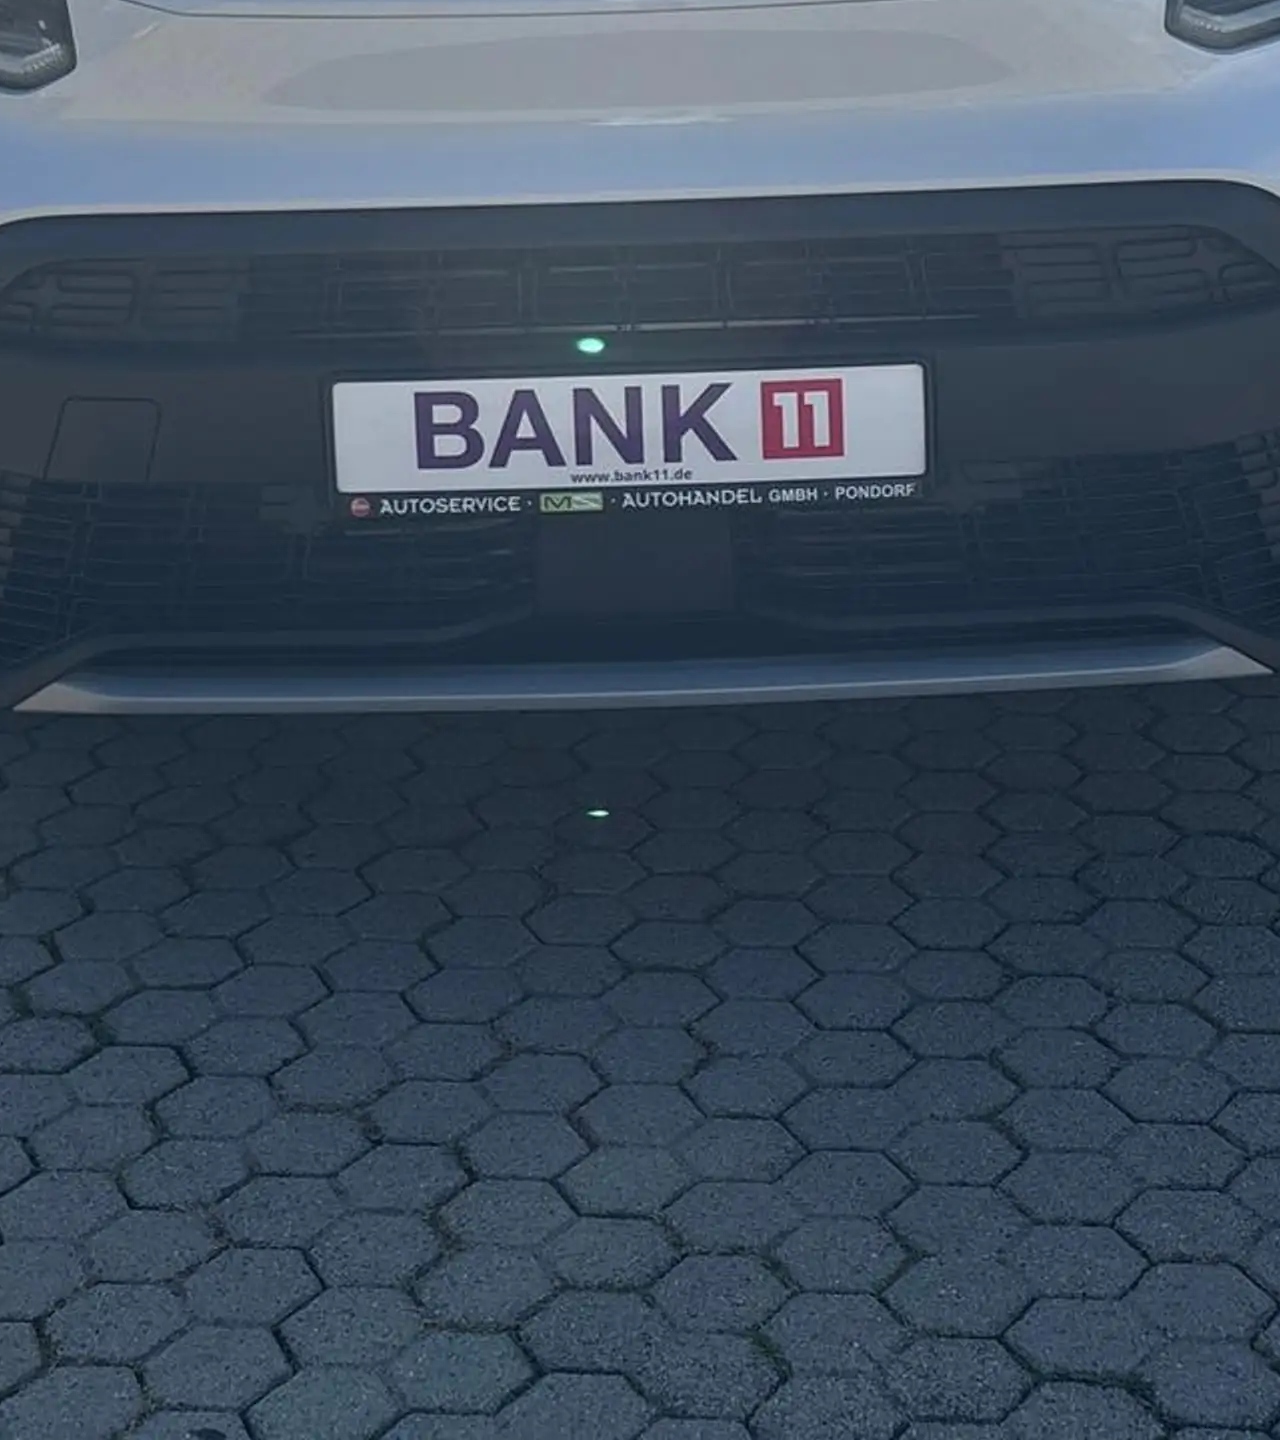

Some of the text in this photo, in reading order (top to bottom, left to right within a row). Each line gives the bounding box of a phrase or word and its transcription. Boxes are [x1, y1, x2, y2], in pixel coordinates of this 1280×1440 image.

[413, 381, 833, 470] BANK 11
[570, 467, 693, 484] www.bank11.de
[380, 495, 522, 515] AUTOSERVICE
[622, 487, 762, 509] AUTOHANDEL
[768, 486, 818, 503] GMBH
[834, 482, 916, 501] PONDORF
